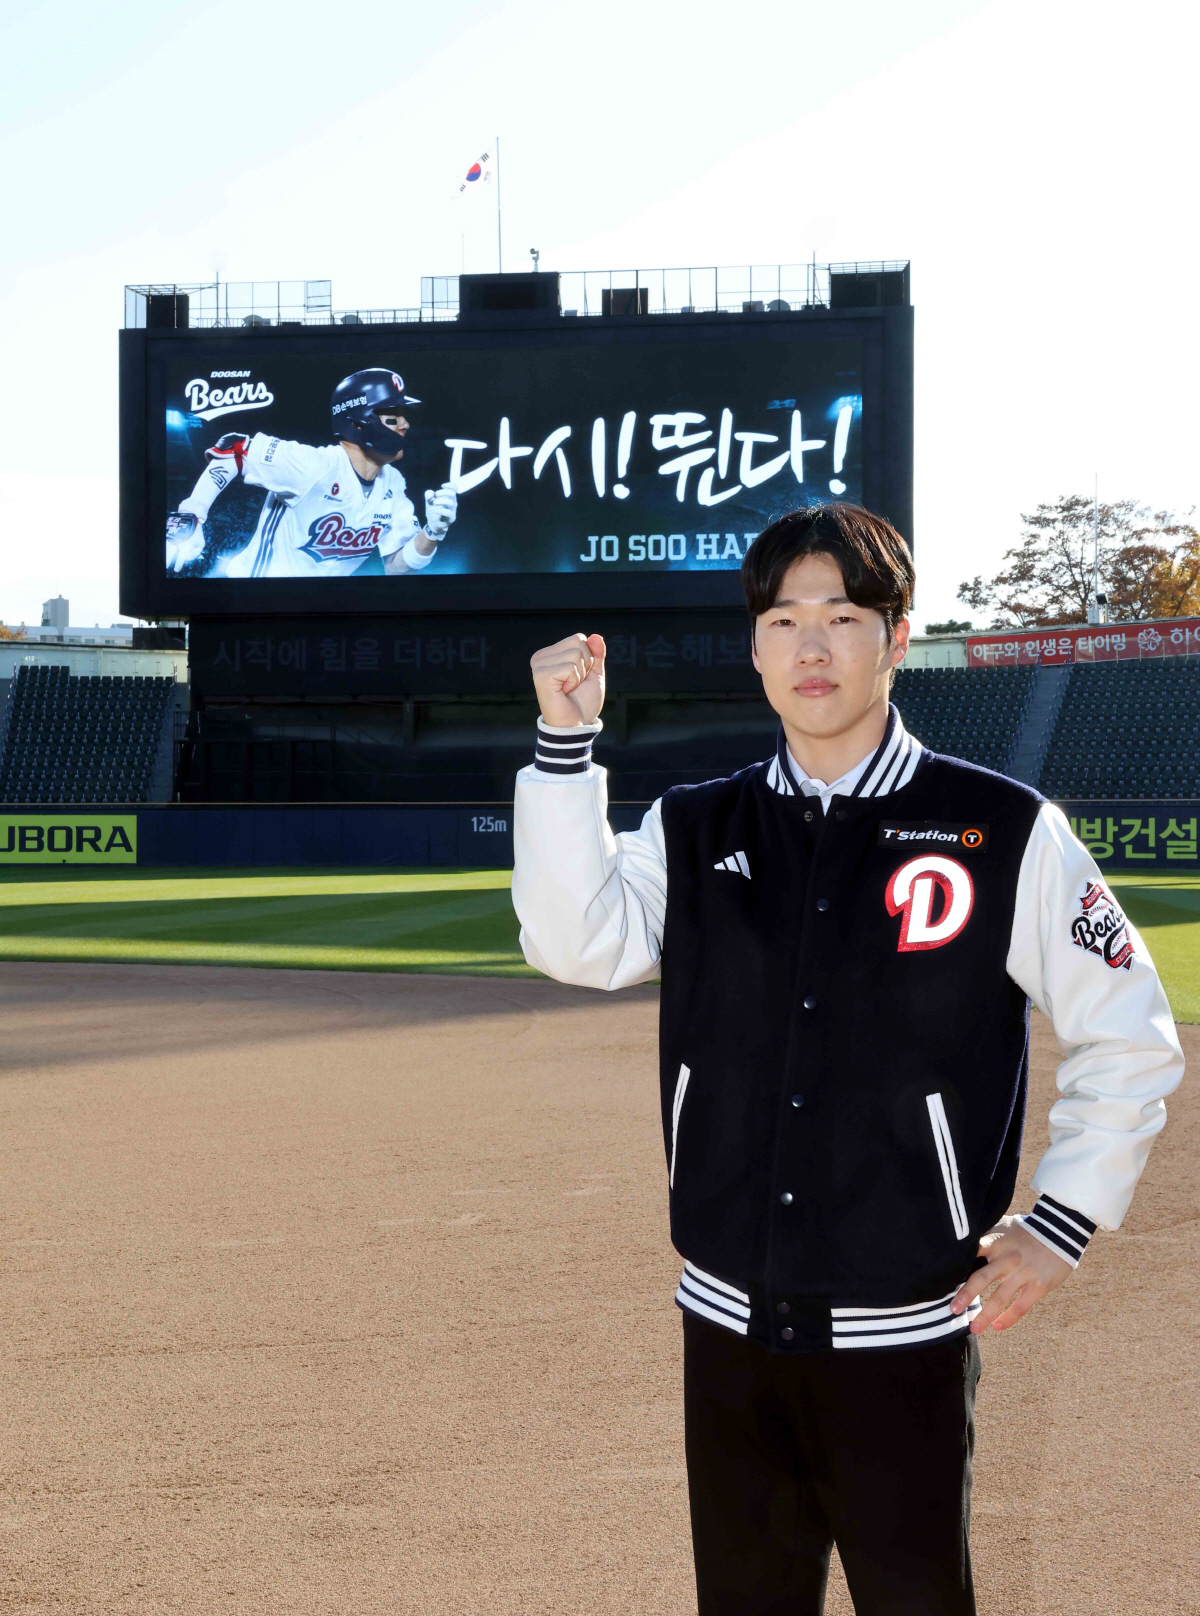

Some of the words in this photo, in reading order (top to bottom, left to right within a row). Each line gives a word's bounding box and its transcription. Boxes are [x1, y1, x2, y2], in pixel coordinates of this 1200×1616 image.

[210, 370, 251, 378] DOOSAN
[185, 378, 274, 421] Bears
[444, 411, 637, 500] 다시!
[649, 406, 853, 506] 뛴다!
[580, 535, 619, 562] JO
[628, 534, 686, 561] SOO
[212, 637, 307, 672] 시작에
[318, 637, 382, 672] 힘을
[393, 635, 491, 671] 더하다
[972, 641, 1021, 661] 야구와
[1025, 637, 1073, 657] 인생은
[1078, 633, 1127, 653] 타이밍
[471, 816, 507, 833] 125m
[883, 828, 959, 843] T'Station
[1070, 817, 1198, 859] 방건설
